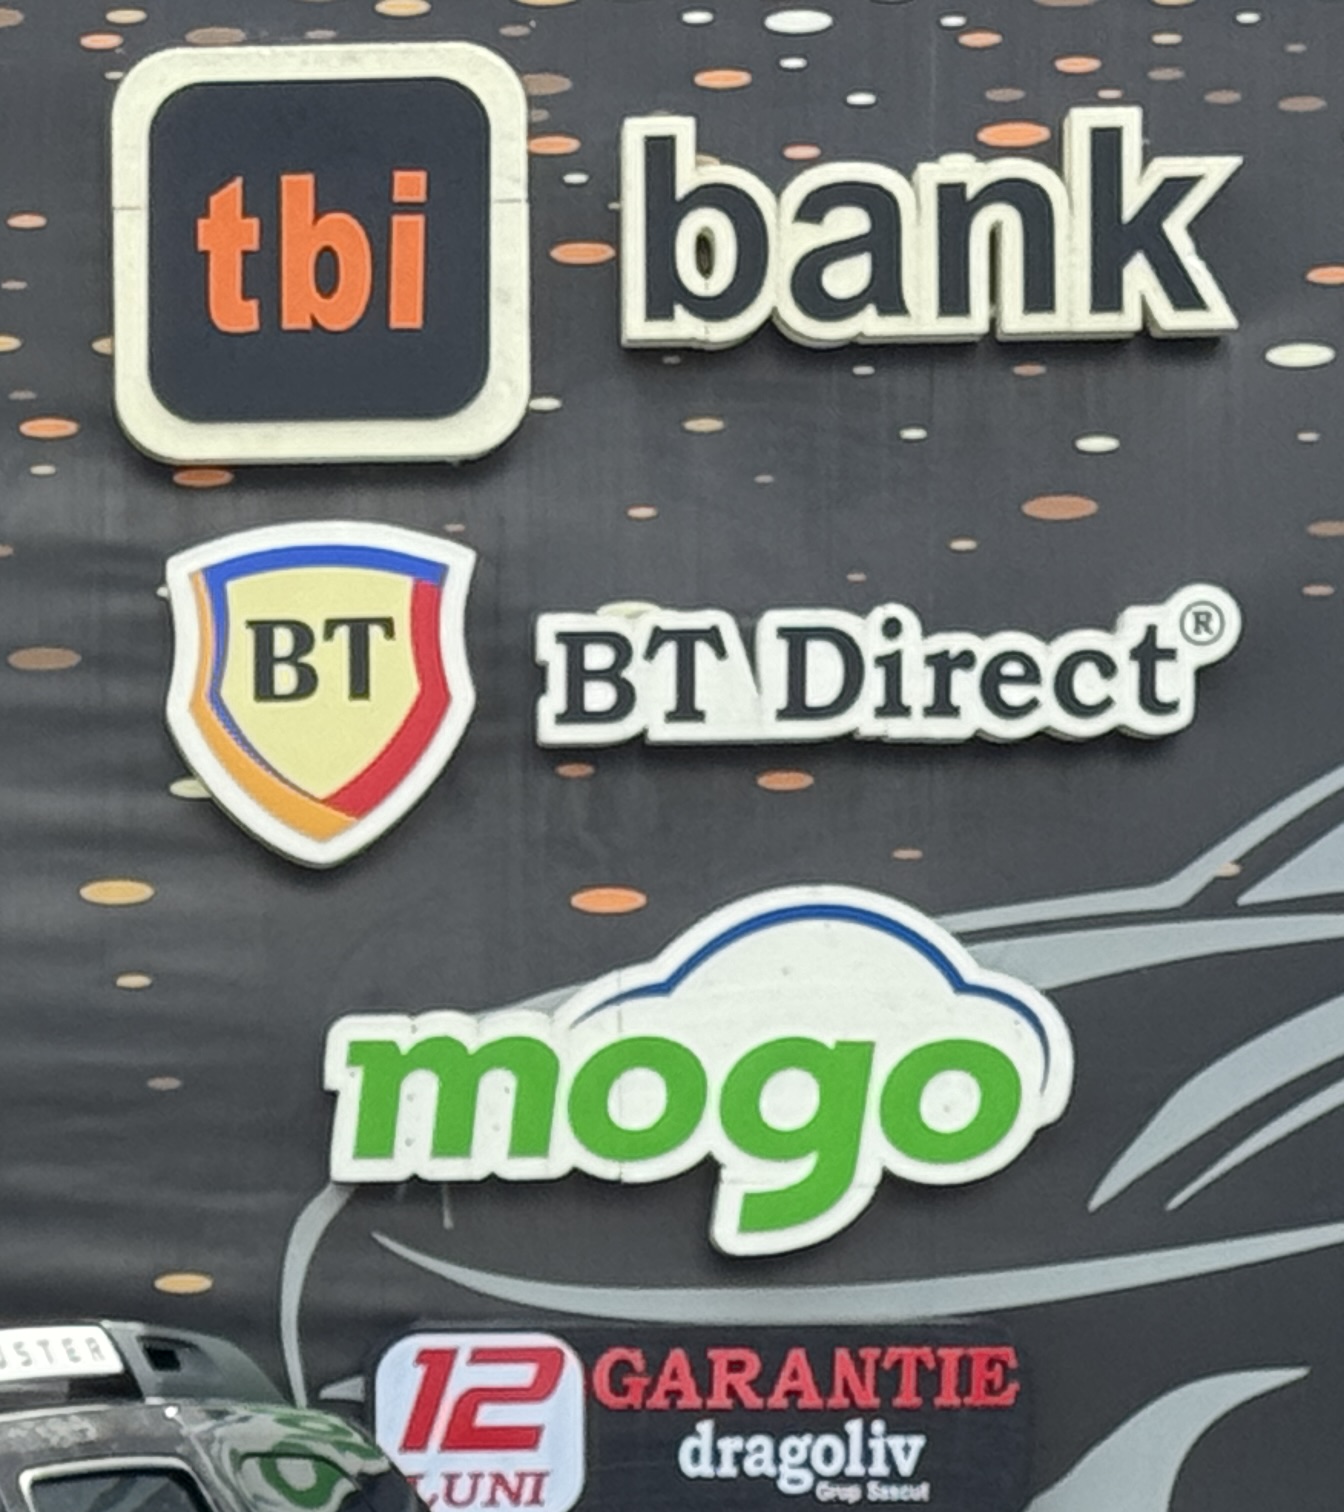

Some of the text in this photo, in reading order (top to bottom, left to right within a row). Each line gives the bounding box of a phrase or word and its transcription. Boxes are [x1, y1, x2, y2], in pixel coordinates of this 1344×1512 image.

[197, 116, 1227, 334] tbi bank
[246, 616, 395, 702] BT
[554, 626, 728, 724] BT
[345, 1034, 1022, 1236] mogo
[400, 1346, 566, 1454] 12
[591, 1346, 1020, 1411] GARANTIE
[678, 1418, 927, 1495] dragoliv
